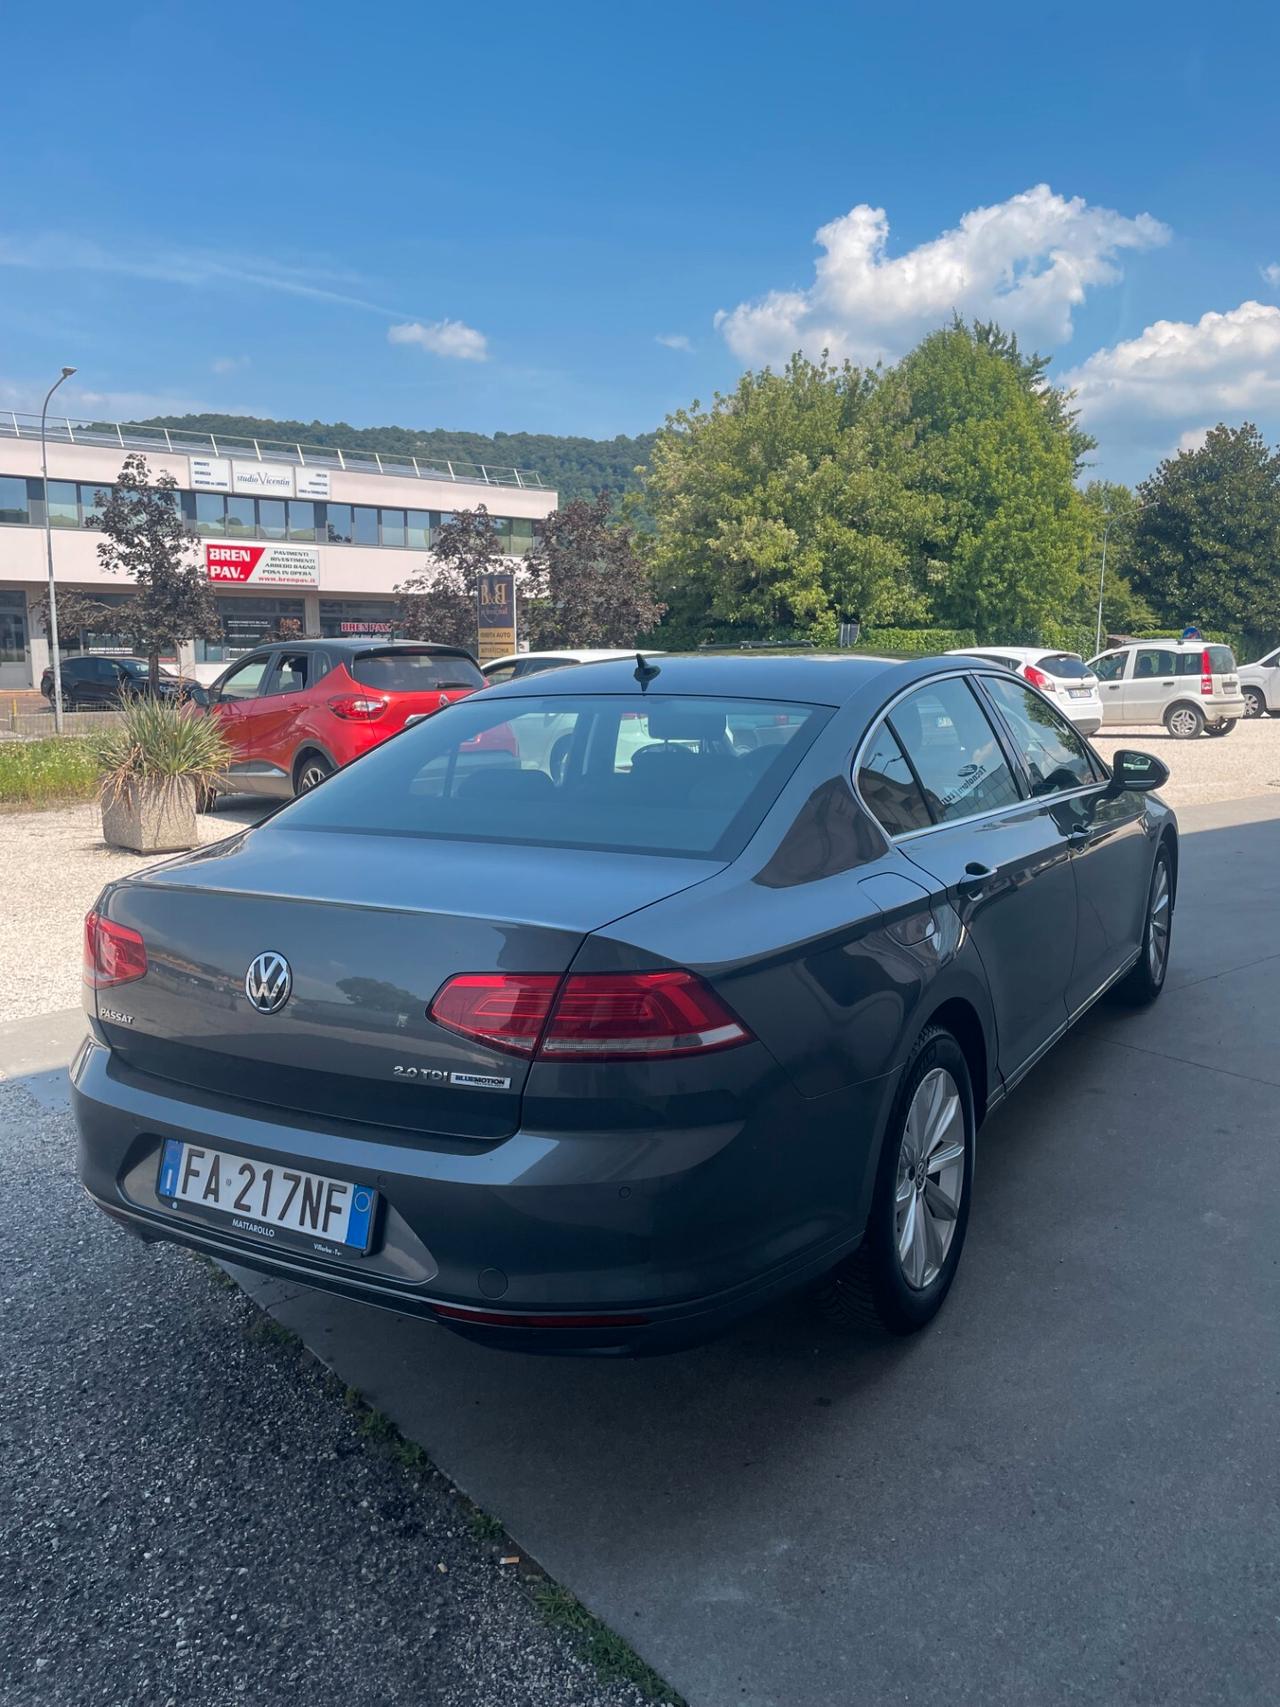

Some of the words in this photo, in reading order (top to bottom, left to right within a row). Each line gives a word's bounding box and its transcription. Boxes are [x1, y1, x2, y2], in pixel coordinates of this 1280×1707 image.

[209, 548, 250, 562] BREN
[210, 565, 245, 579] PAV.
[100, 1008, 134, 1024] PASSAT
[393, 1065, 418, 1078] 2.0
[420, 1068, 448, 1081] TDI
[455, 1074, 505, 1085] BLUEMOTION
[232, 1218, 275, 1238] MATTAROLLO
